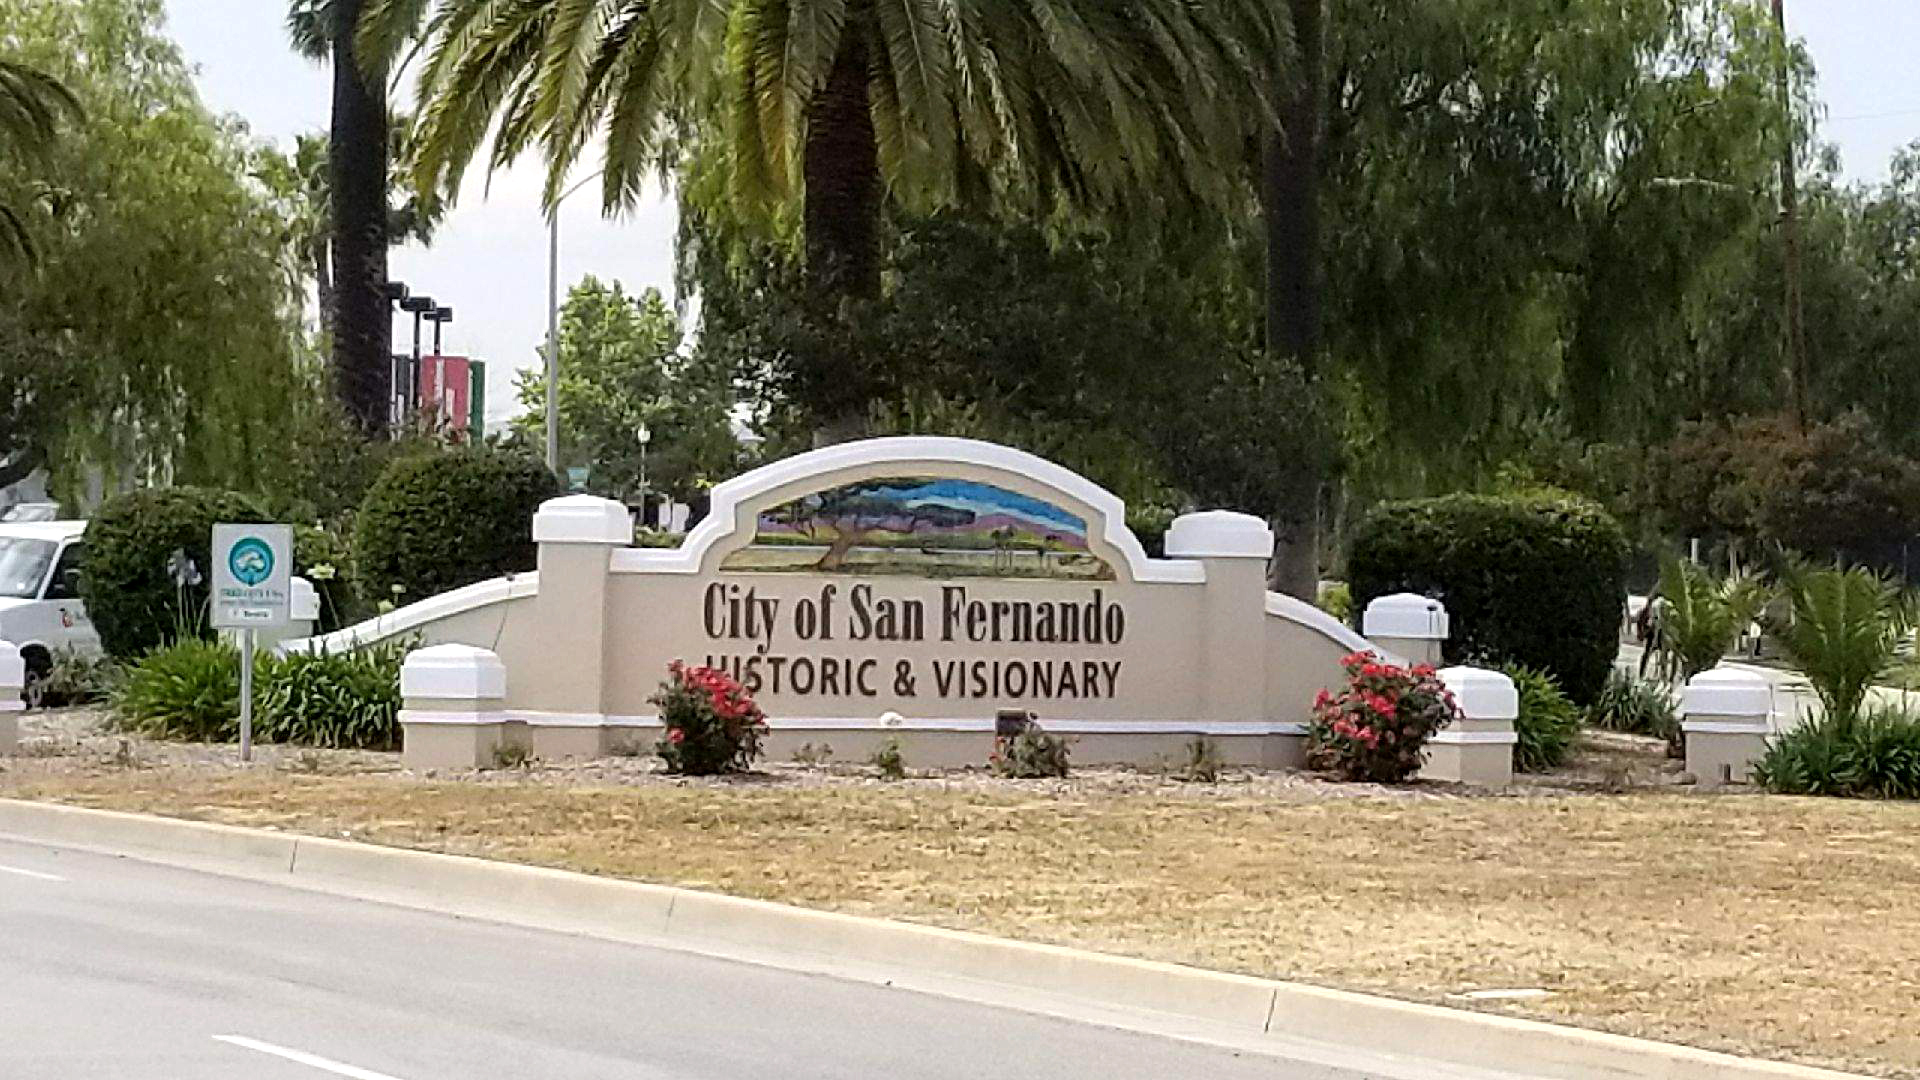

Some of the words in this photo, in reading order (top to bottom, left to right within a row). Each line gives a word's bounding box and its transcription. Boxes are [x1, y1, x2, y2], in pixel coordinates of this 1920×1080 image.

[704, 582, 779, 653] City
[794, 584, 837, 639] of
[849, 584, 924, 640] San
[941, 587, 1125, 644] Fernando
[893, 658, 916, 696] &
[932, 661, 1121, 698] VISIONARY
